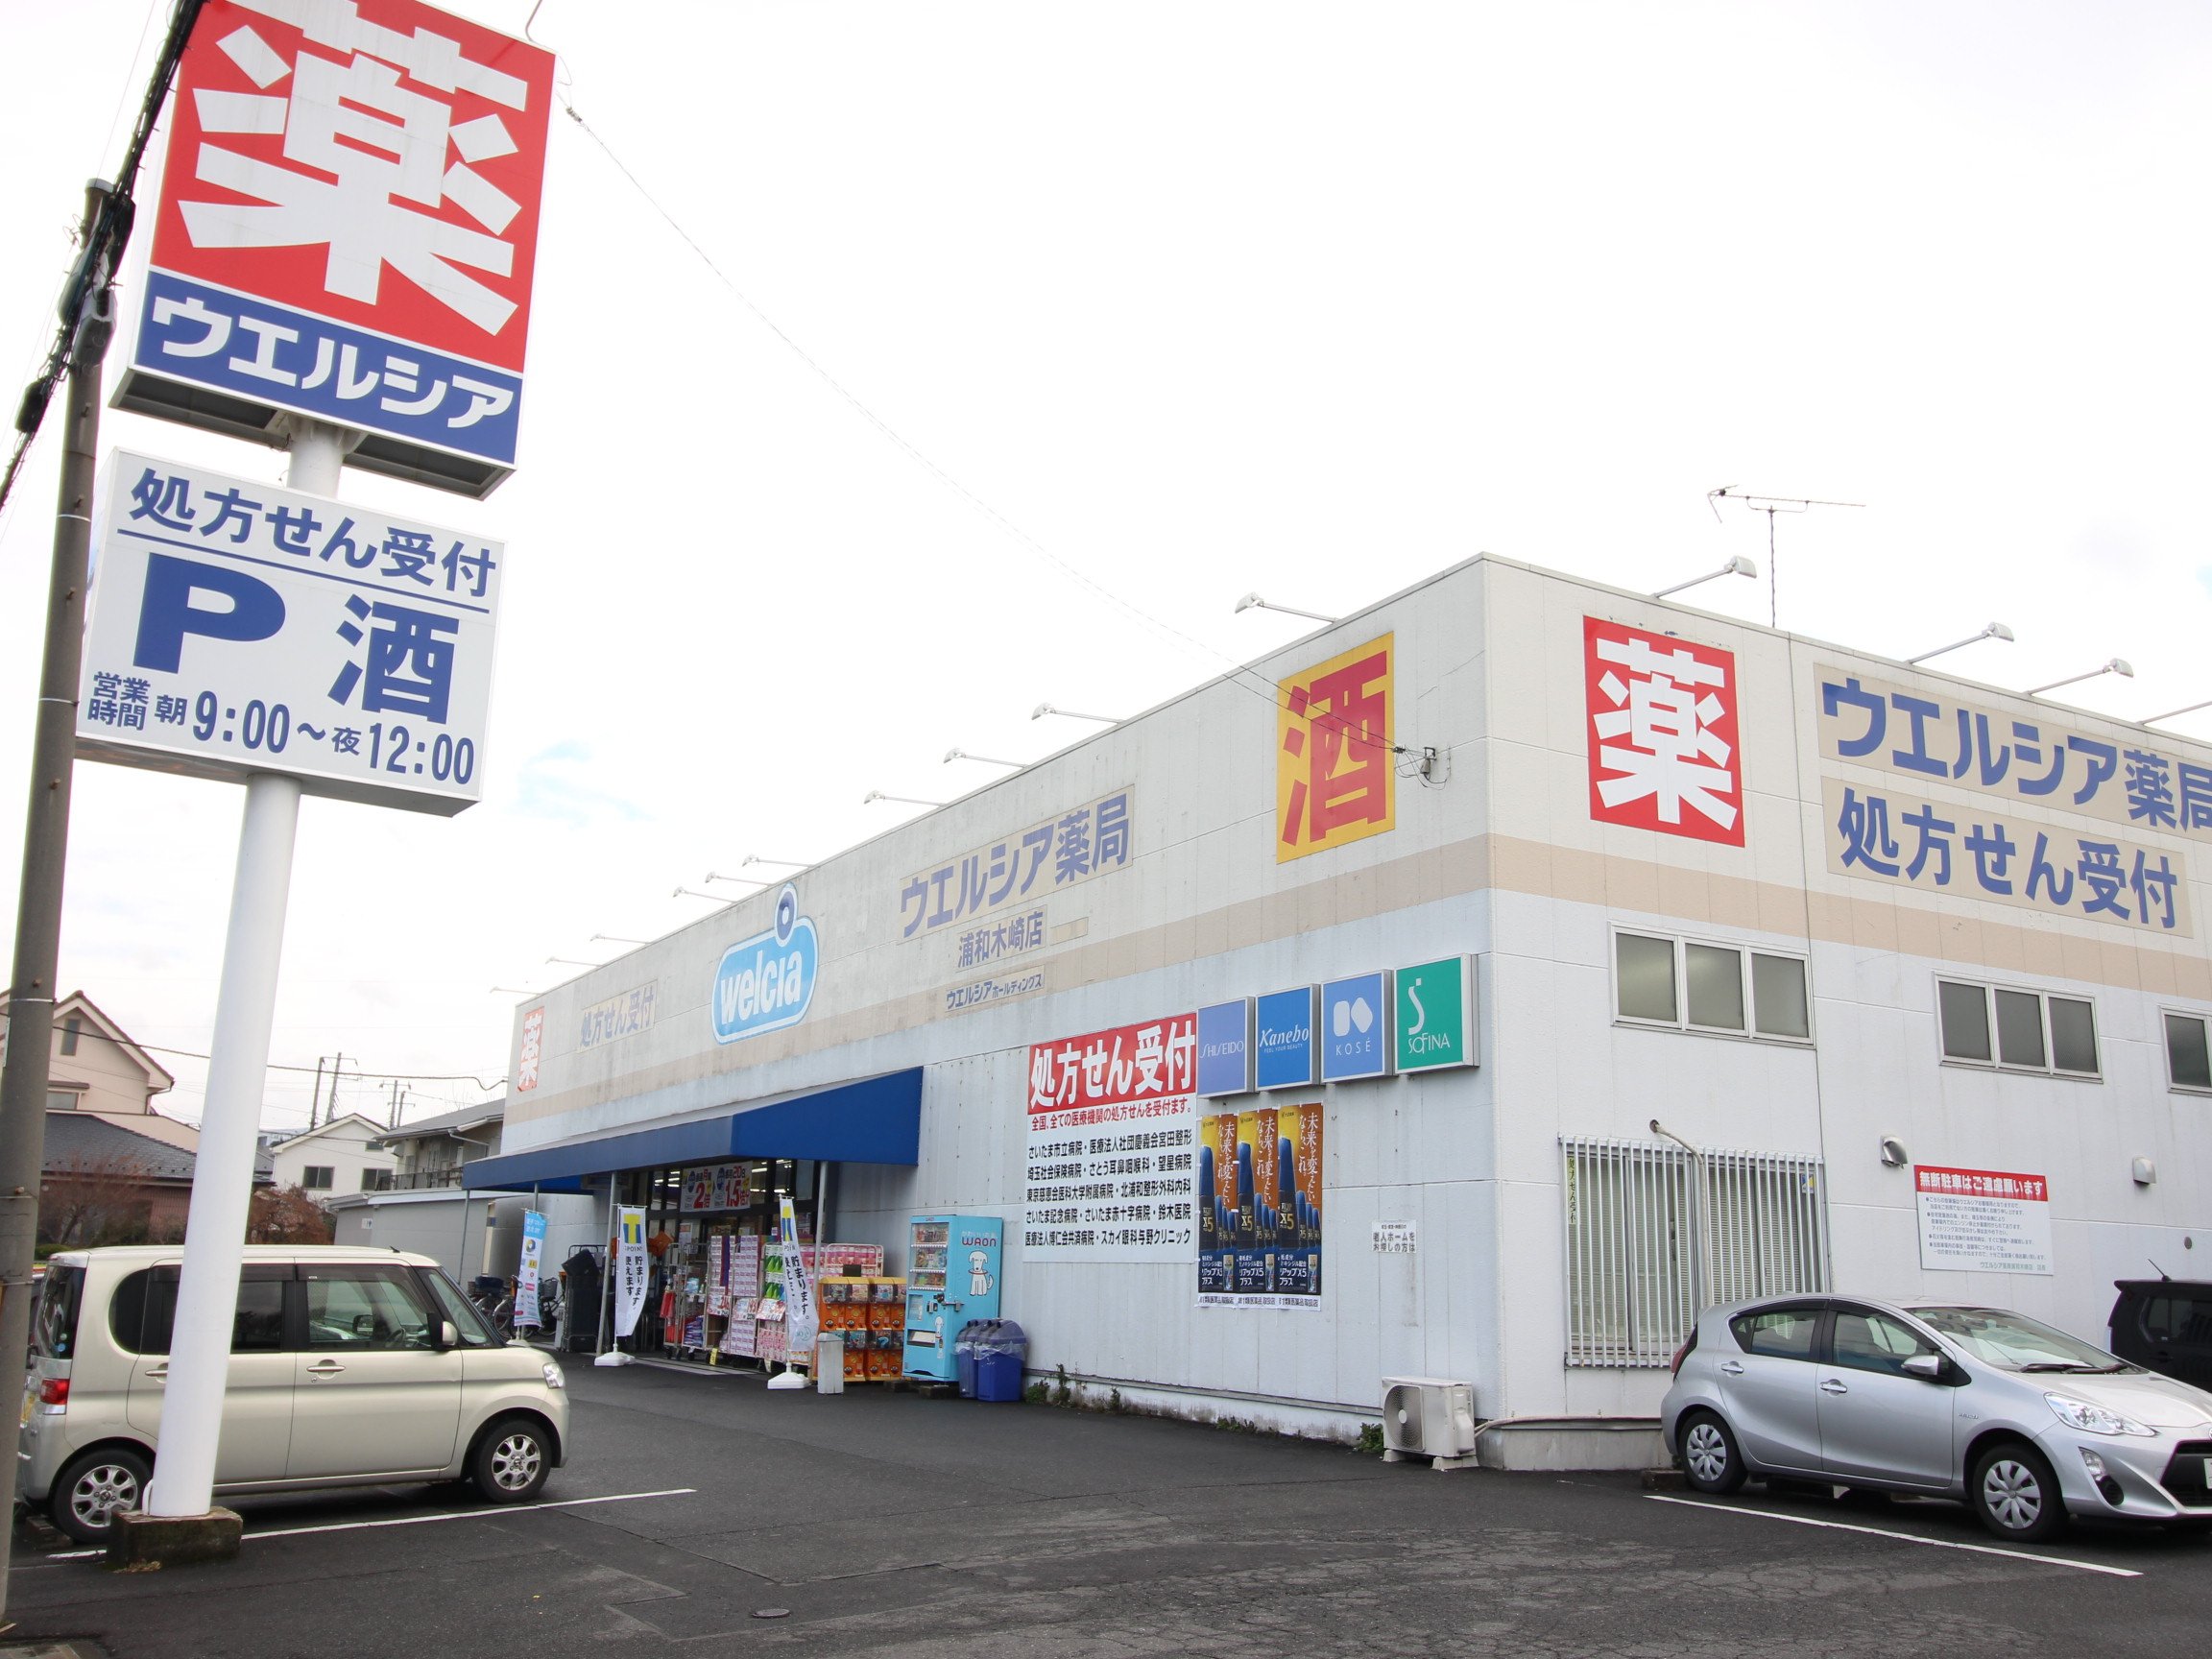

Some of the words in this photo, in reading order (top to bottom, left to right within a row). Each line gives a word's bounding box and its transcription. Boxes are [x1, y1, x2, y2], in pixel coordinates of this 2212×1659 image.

[178, 0, 529, 336] 薬
[152, 297, 515, 429] ウエルシア
[130, 469, 496, 597] 処方せん受付
[132, 552, 286, 674] P
[327, 593, 459, 726] 酒
[87, 698, 147, 731] 時間
[93, 672, 151, 704] 営業
[1283, 650, 1388, 847] 酒
[1593, 637, 1738, 832] 薬
[1823, 678, 2212, 834] ウエルシア薬局
[901, 793, 1129, 939] ウエルシア薬局
[1838, 787, 2178, 929] 処方せん受付
[958, 911, 1044, 969] 浦和木崎店
[580, 985, 655, 1047] 処方せん受付
[1200, 1040, 1244, 1059] SHISEIDO
[1260, 1023, 1310, 1047] Kanebo
[1336, 1038, 1372, 1056] KOSÉ
[519, 1014, 543, 1090] 薬
[1030, 1020, 1196, 1110] 処方せん受付
[1919, 1170, 2043, 1195] 無断駐車はご遠慮願います
[961, 1236, 997, 1247] WAON
[1241, 1215, 1253, 1232] X5
[1280, 1214, 1294, 1230] X5
